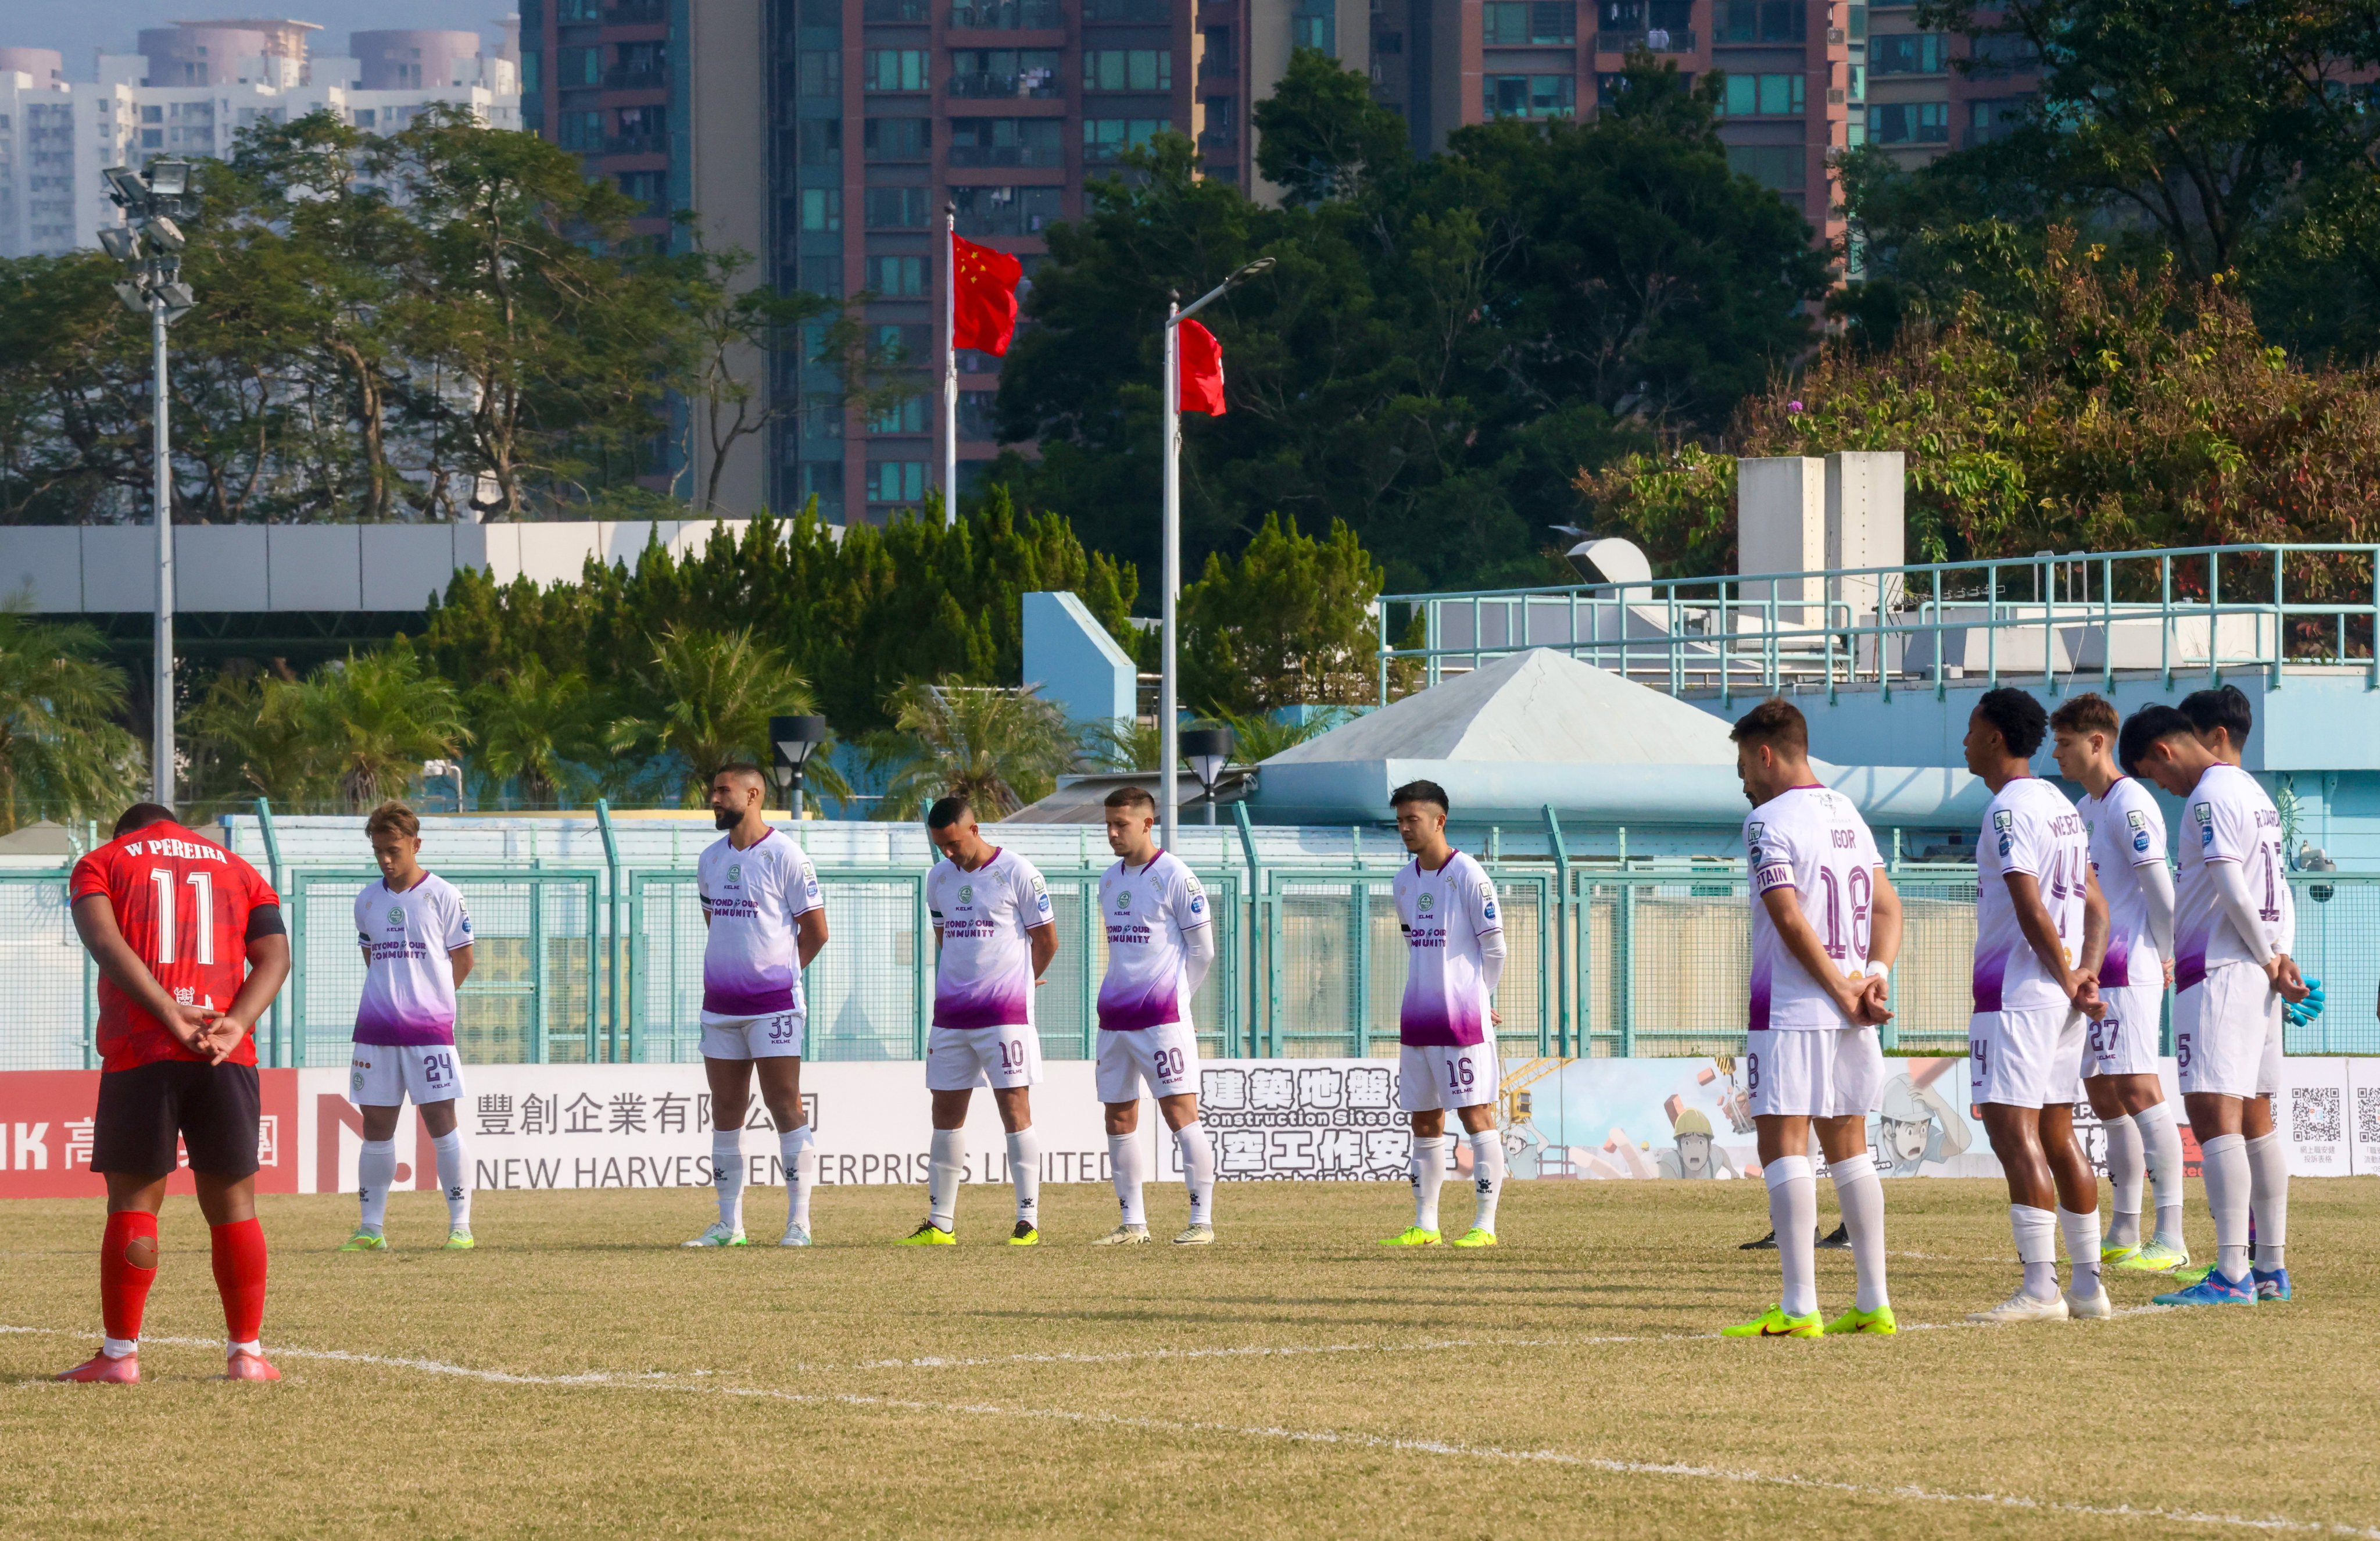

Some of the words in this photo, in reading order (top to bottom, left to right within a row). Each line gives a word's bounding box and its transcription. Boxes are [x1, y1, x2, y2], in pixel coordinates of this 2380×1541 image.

[124, 841, 144, 857] W
[147, 838, 228, 864] PEREIRA
[1830, 829, 1856, 849] IGOR
[151, 867, 214, 965] 11
[742, 900, 758, 908] OUR
[1820, 865, 1870, 960] 18
[372, 941, 399, 952] BEYOND
[409, 941, 426, 950] OUR
[768, 1016, 793, 1038] 33
[2089, 1020, 2119, 1051] 27
[424, 1053, 453, 1082] 24
[999, 1039, 1023, 1068] 10
[1154, 1047, 1184, 1079] 20
[1162, 1077, 1183, 1085] KELME
[1447, 1057, 1474, 1087] 16
[1201, 1067, 1401, 1110] 建築地盤
[1199, 1110, 1329, 1127] Construction
[1333, 1109, 1388, 1127] Sites
[1173, 1129, 1459, 1173] 空工作安
[476, 1159, 561, 1190] NEW
[575, 1155, 713, 1189] HARVES
